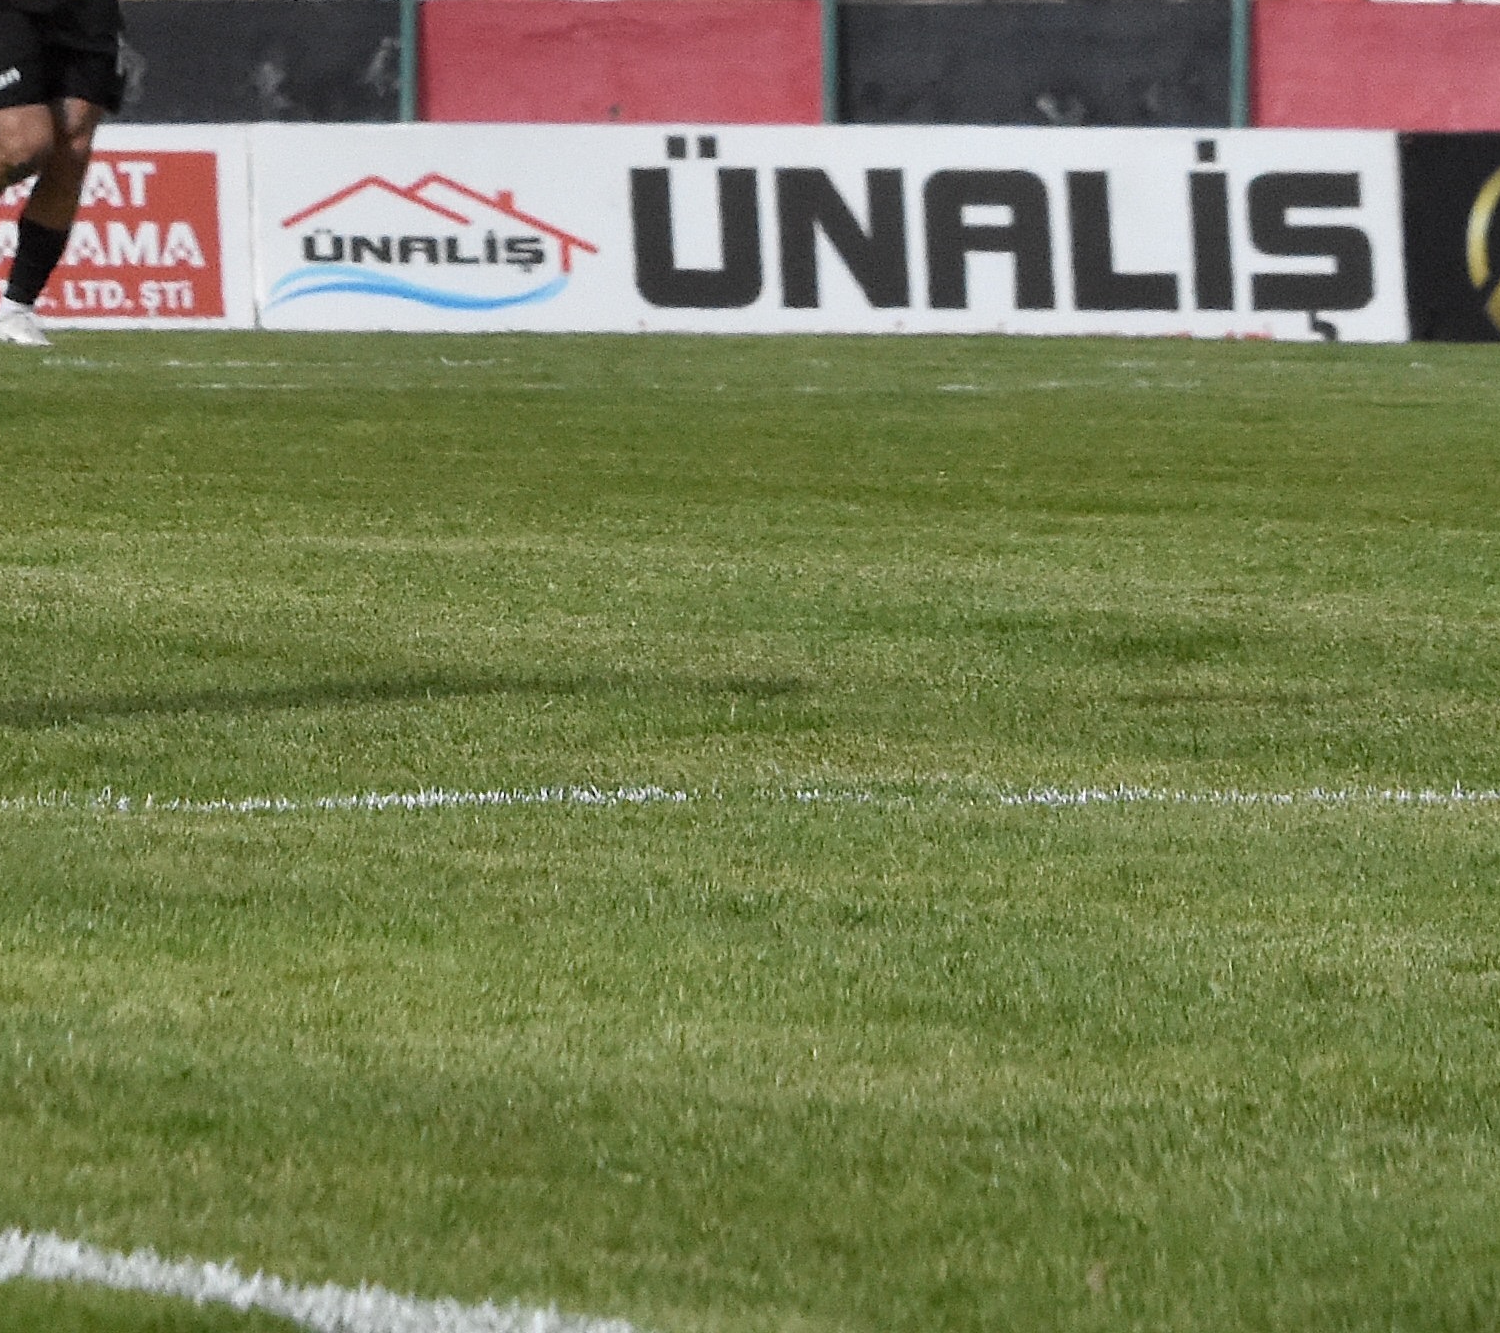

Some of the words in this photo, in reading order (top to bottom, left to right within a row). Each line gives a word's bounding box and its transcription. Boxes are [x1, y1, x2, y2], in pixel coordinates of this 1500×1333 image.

[303, 228, 547, 274] ÜNALİŞ
[630, 136, 1376, 341] ÜNALİŞ
[62, 280, 135, 311] LTD.
